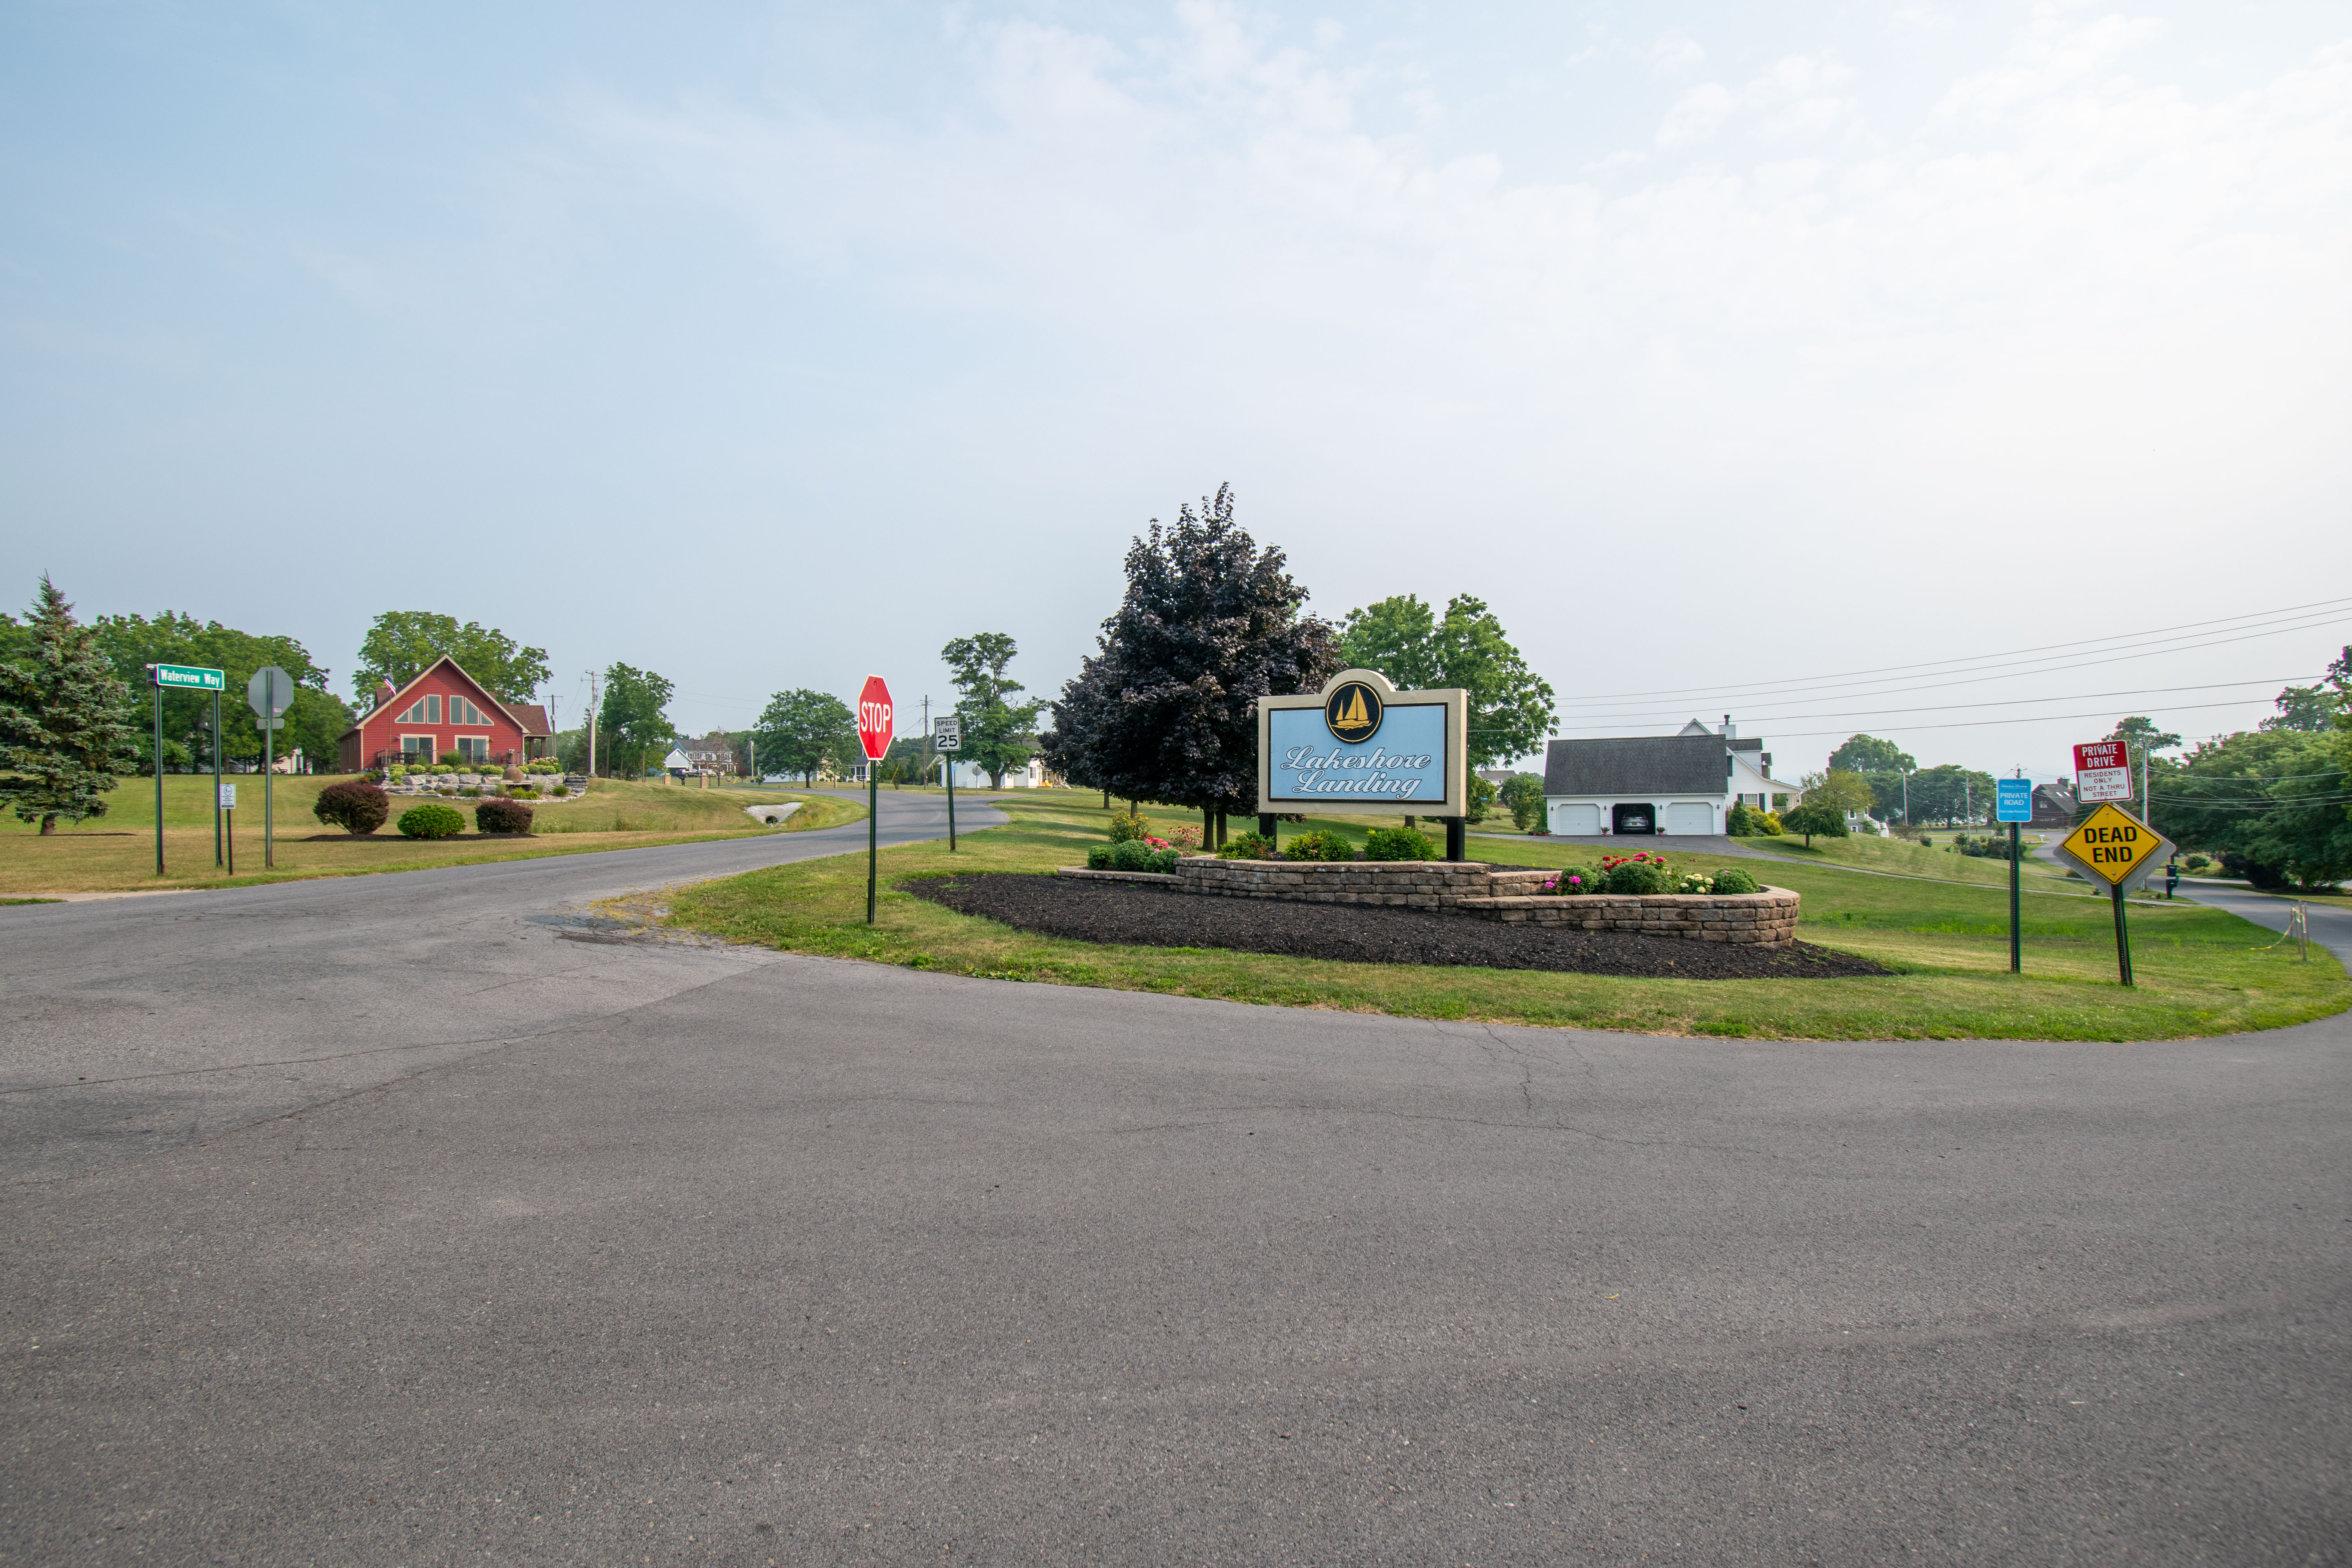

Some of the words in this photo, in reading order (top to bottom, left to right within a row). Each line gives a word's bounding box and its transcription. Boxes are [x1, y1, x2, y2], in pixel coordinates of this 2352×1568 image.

[160, 669, 200, 683] Waterview
[204, 673, 220, 688] Way
[861, 701, 891, 733] STOP
[938, 735, 958, 747] 25
[1280, 745, 1431, 769] Lakeshore
[2082, 744, 2118, 757] PRIVATE
[2087, 756, 2116, 768] DRIVE
[1292, 769, 1422, 800] Landing
[2084, 826, 2137, 843] DEAD
[2092, 847, 2132, 862] END
